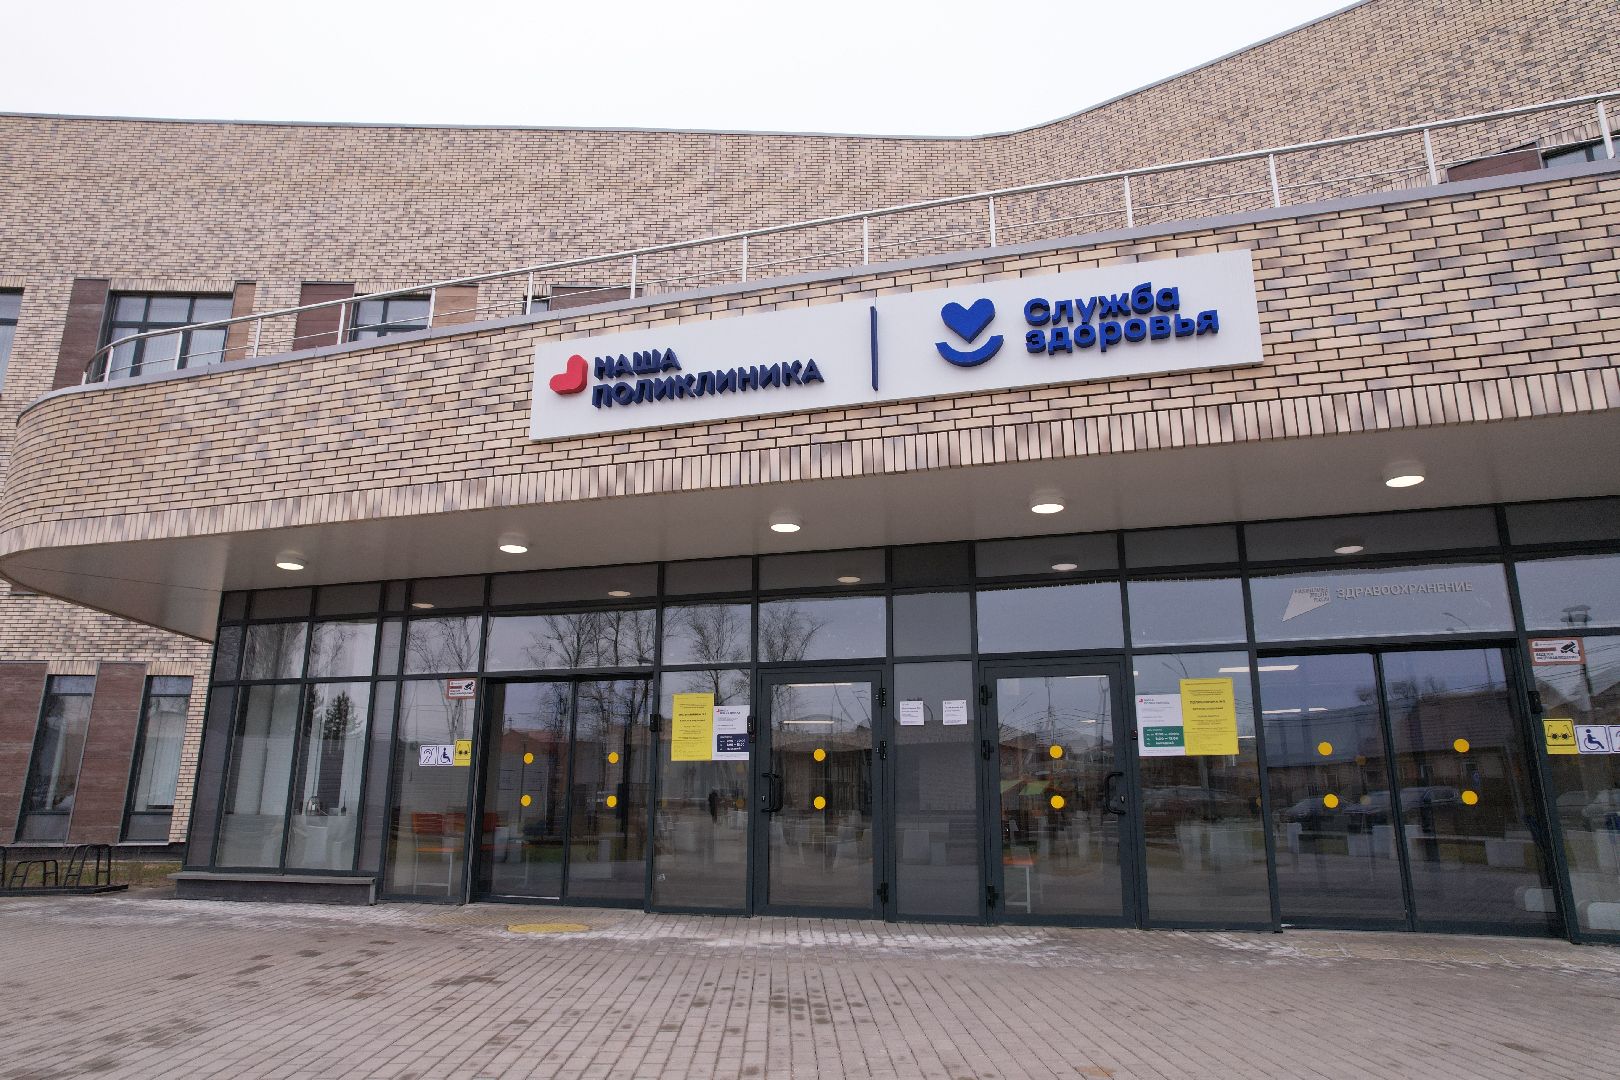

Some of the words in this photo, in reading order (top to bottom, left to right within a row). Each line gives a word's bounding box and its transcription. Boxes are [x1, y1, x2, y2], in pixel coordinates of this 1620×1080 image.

[1023, 282, 1180, 326] Служба
[1025, 310, 1220, 355] здоровья
[592, 358, 825, 409] ПОЛИКЛИНИКА
[594, 348, 682, 380] НАША
[1336, 581, 1473, 600] ЗДРАВООХРАНЕНИЕ
